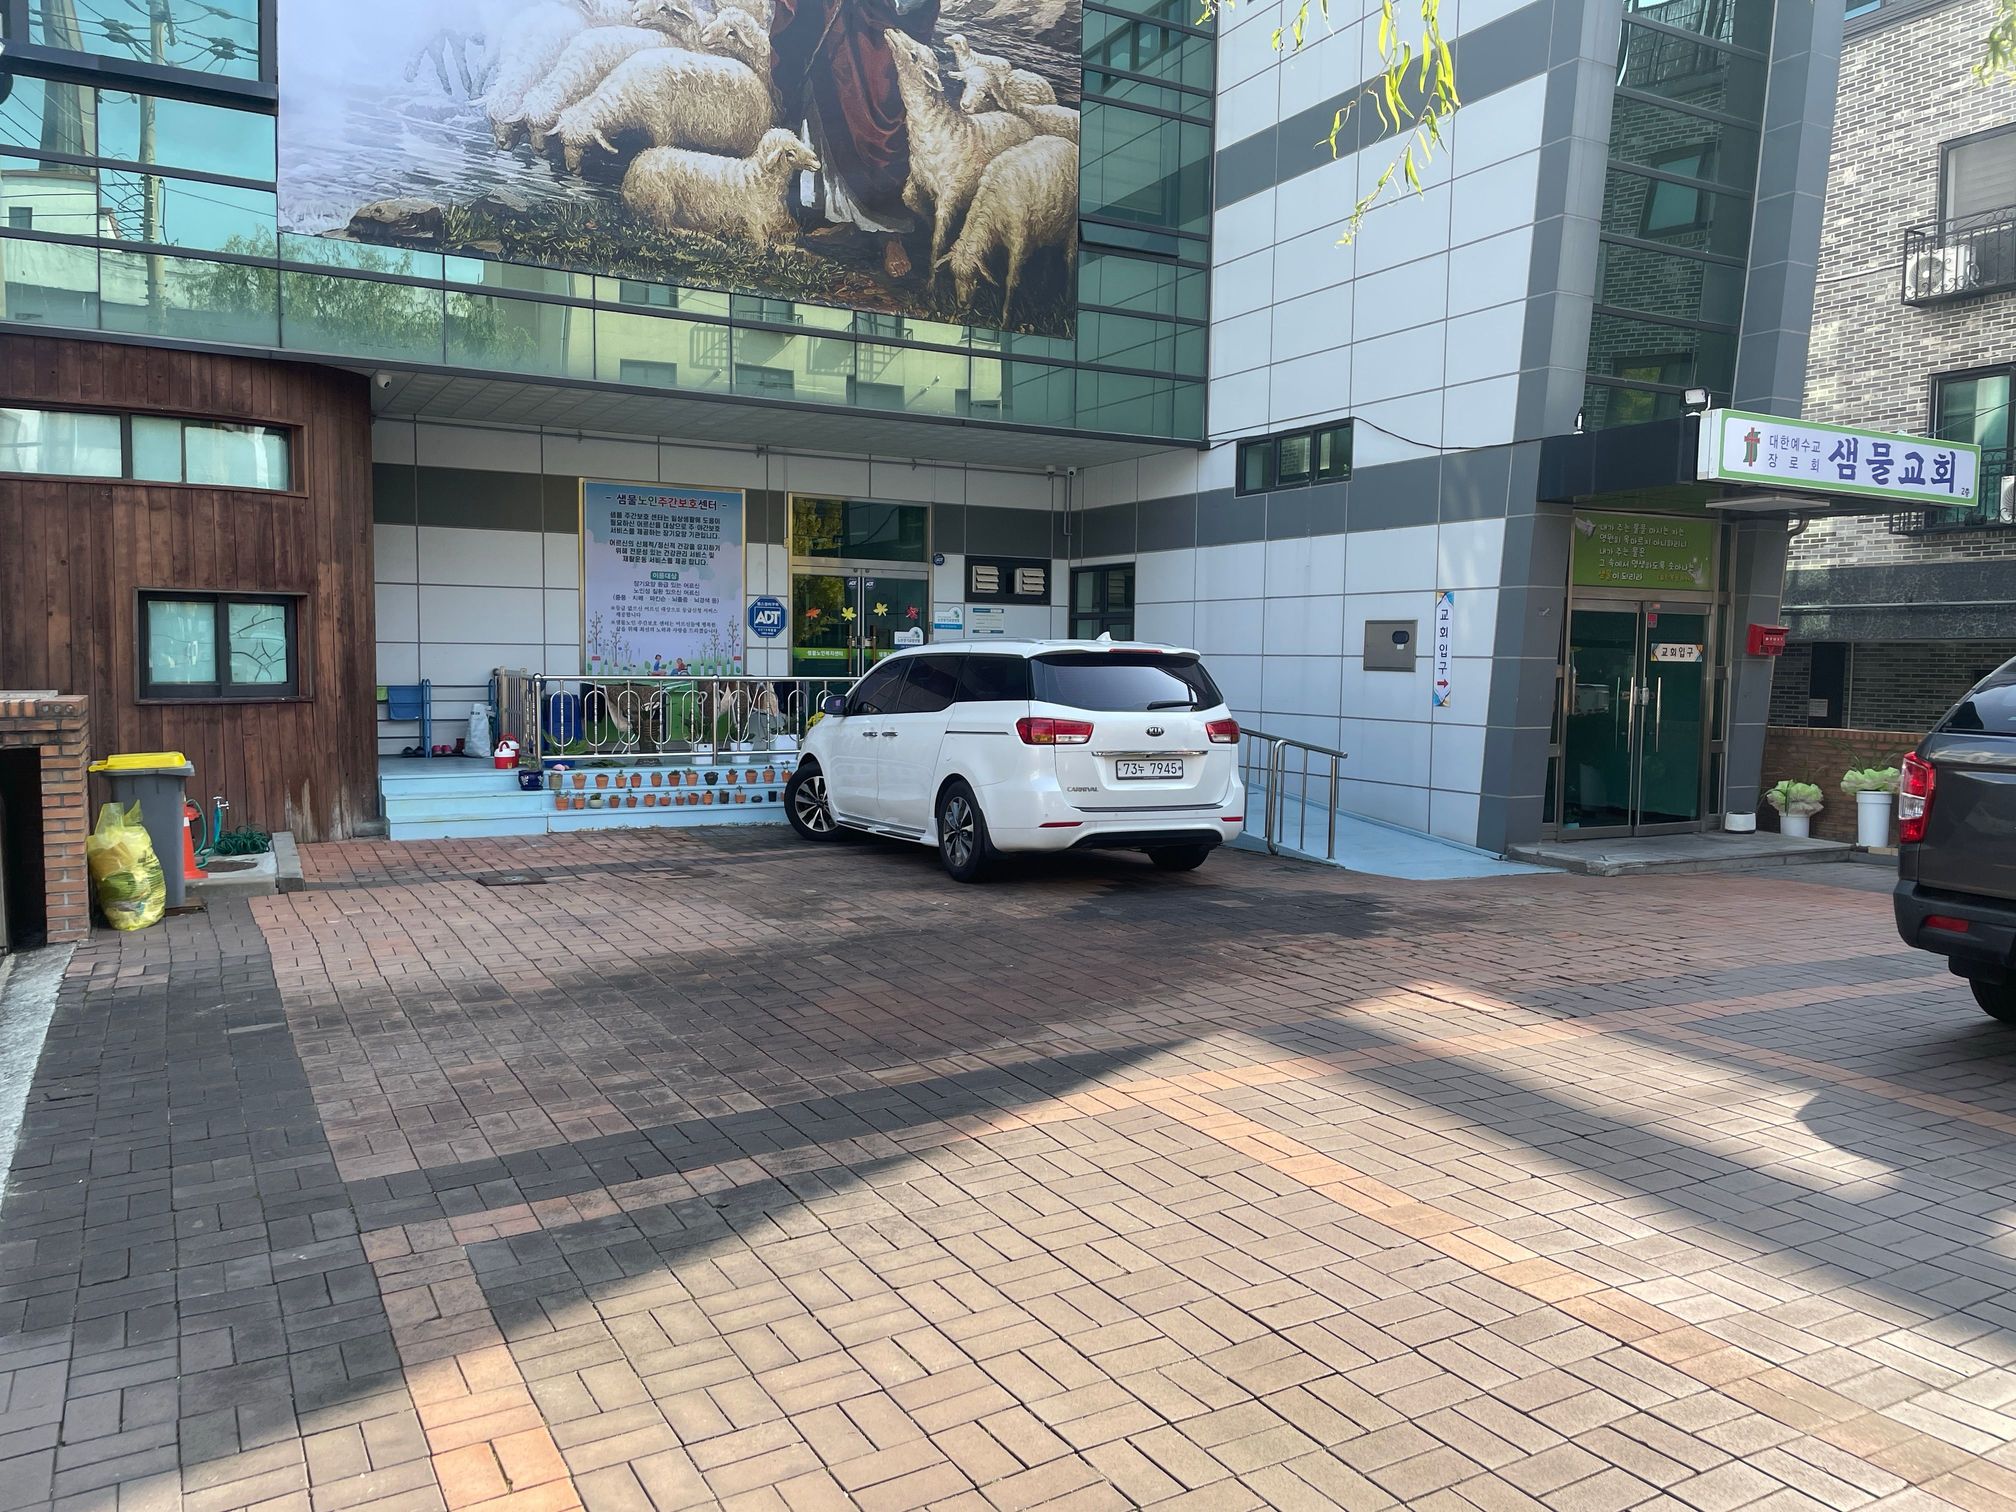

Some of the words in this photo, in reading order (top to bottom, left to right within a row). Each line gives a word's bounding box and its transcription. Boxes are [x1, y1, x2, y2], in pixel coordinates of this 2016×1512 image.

[1769, 435, 1821, 453] 대한예수교
[1768, 453, 1820, 473] 장로회
[1828, 437, 1956, 494] 샘물교회
[1961, 487, 1970, 498] 2층
[616, 494, 717, 510] 샘물노인주간보호센터
[624, 512, 649, 520] 주간보호
[651, 514, 669, 522] 센터는
[610, 527, 634, 535] 서비스를
[636, 528, 660, 536] 제공하는
[662, 530, 687, 538] 장기요양
[662, 522, 687, 530] 대상으로
[610, 539, 634, 547] 어르신의
[678, 542, 695, 550] 건강을
[696, 544, 720, 552] 유지하기
[616, 547, 628, 555] 위해
[664, 550, 688, 558] 건강관리
[689, 550, 707, 558] 서비스
[622, 556, 647, 564] 재활운동
[649, 556, 672, 564] 서비스를
[754, 610, 780, 625] ADT
[1438, 608, 1449, 675] 교회입구
[1661, 646, 1694, 658] 교회입구
[1123, 763, 1144, 775] 73누
[1150, 762, 1178, 774] 7945
